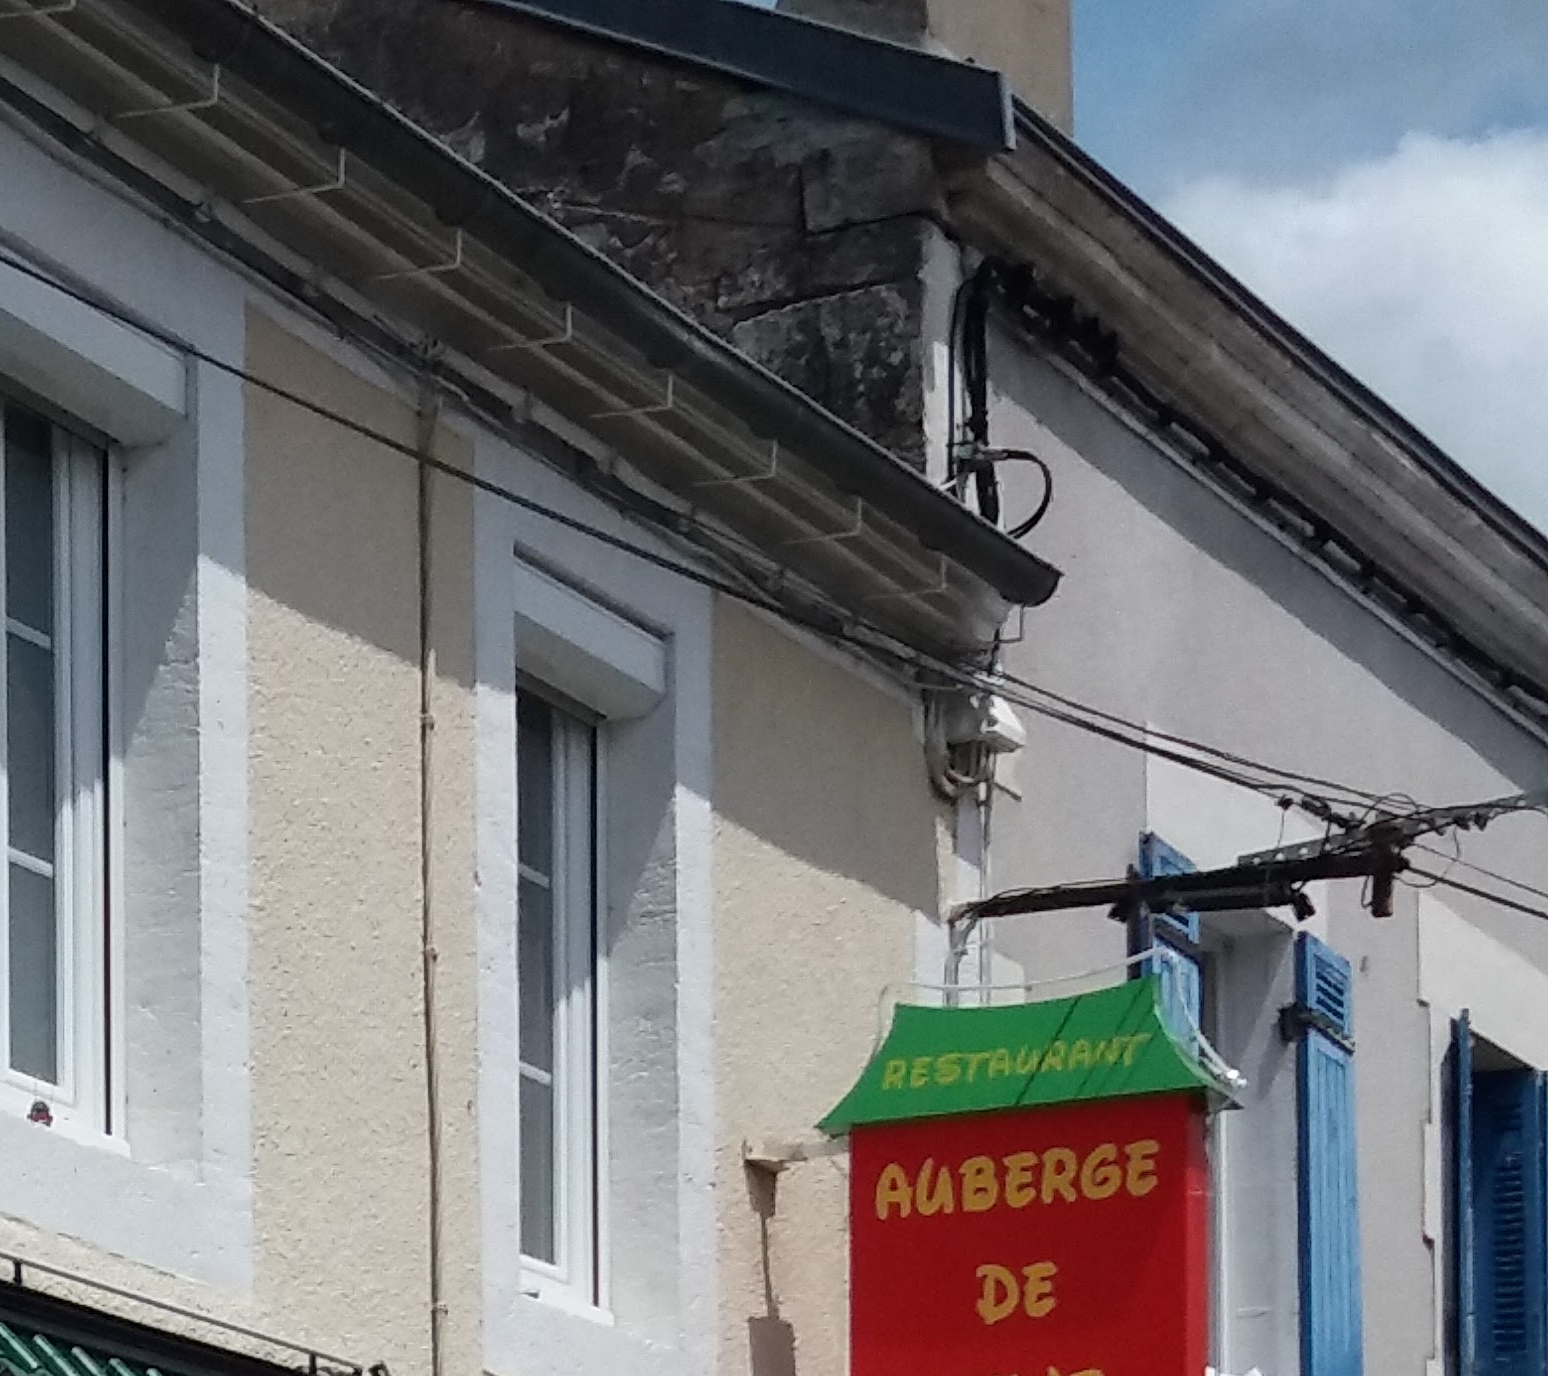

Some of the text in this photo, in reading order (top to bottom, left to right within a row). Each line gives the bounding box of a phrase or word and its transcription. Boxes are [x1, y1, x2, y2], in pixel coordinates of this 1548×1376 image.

[882, 1032, 1152, 1090] RESTAURANT
[875, 1139, 1160, 1221] AUBERGE
[975, 1261, 1058, 1325] DE
